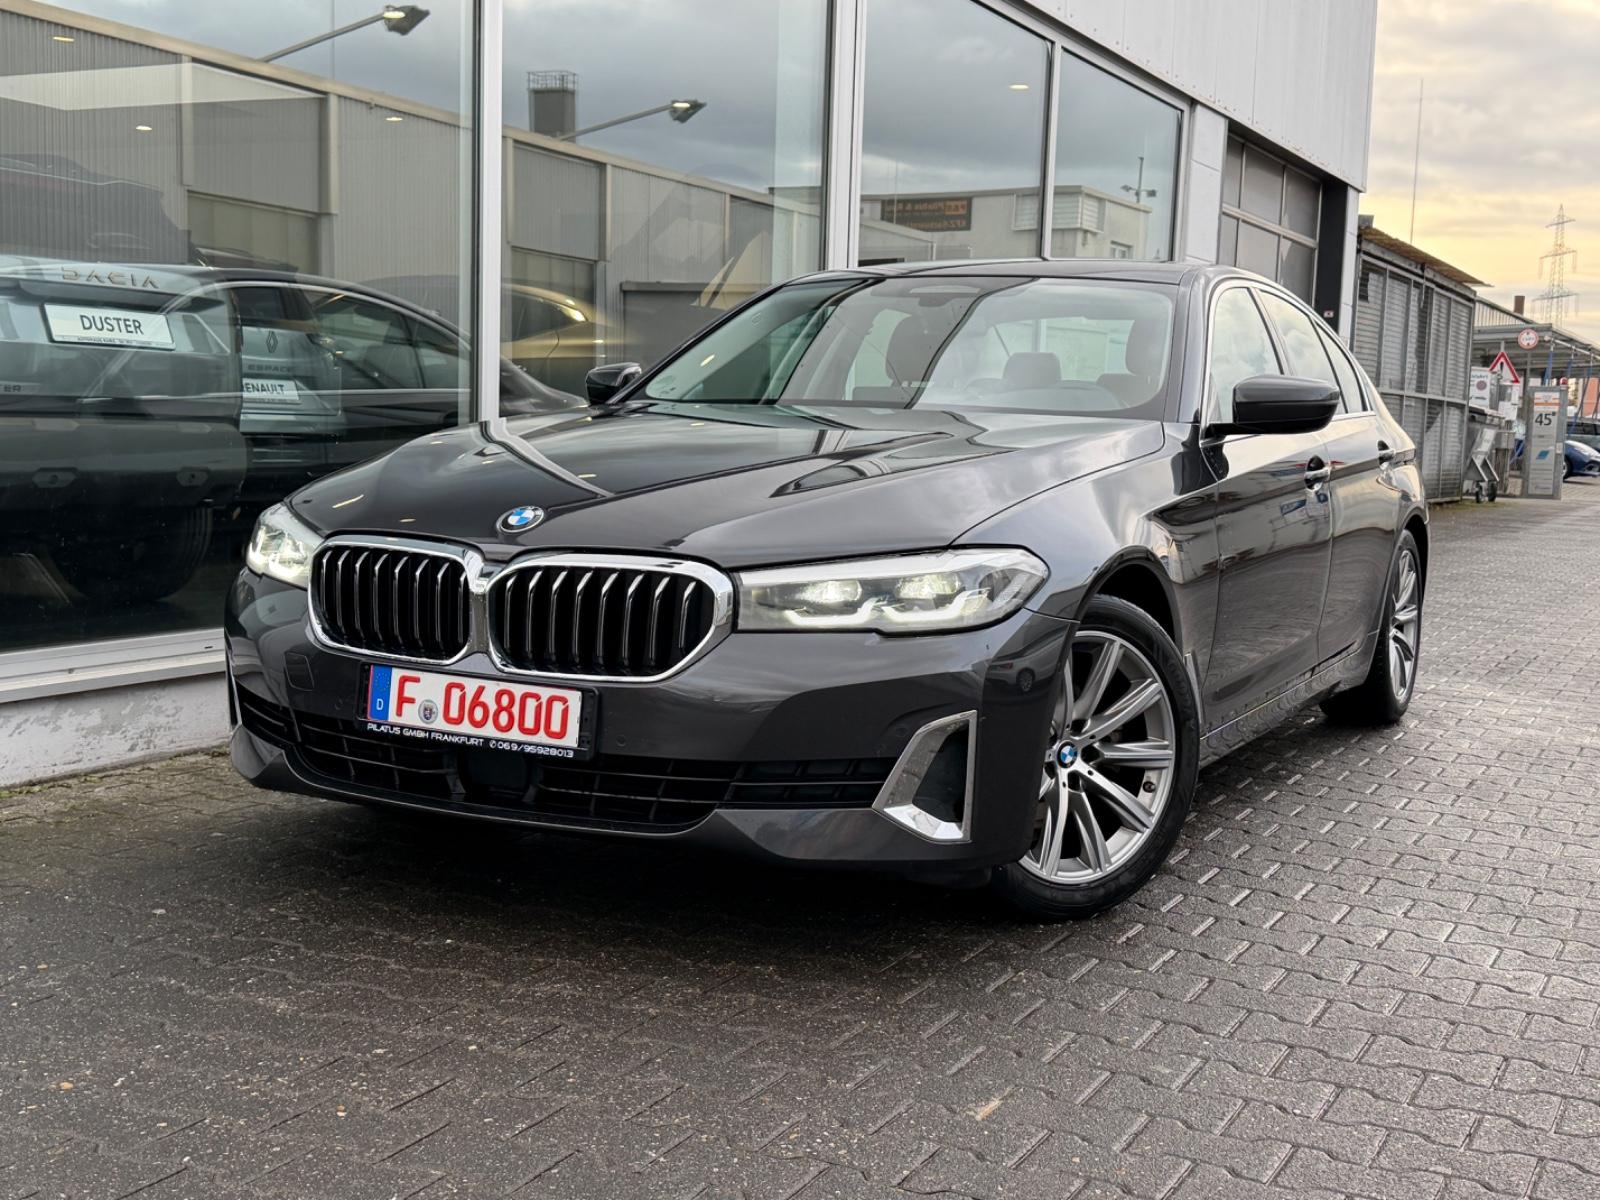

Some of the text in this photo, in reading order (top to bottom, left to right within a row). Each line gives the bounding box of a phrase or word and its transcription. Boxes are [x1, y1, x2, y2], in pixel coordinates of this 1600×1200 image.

[61, 266, 159, 289] DACIA
[80, 314, 144, 335] DUSTER
[242, 382, 285, 395] ENAULT
[376, 699, 384, 711] D
[396, 675, 569, 740] F 06800
[367, 723, 401, 735] PILATUS
[402, 728, 429, 739] GMBH
[430, 732, 484, 747] FRANKFURT
